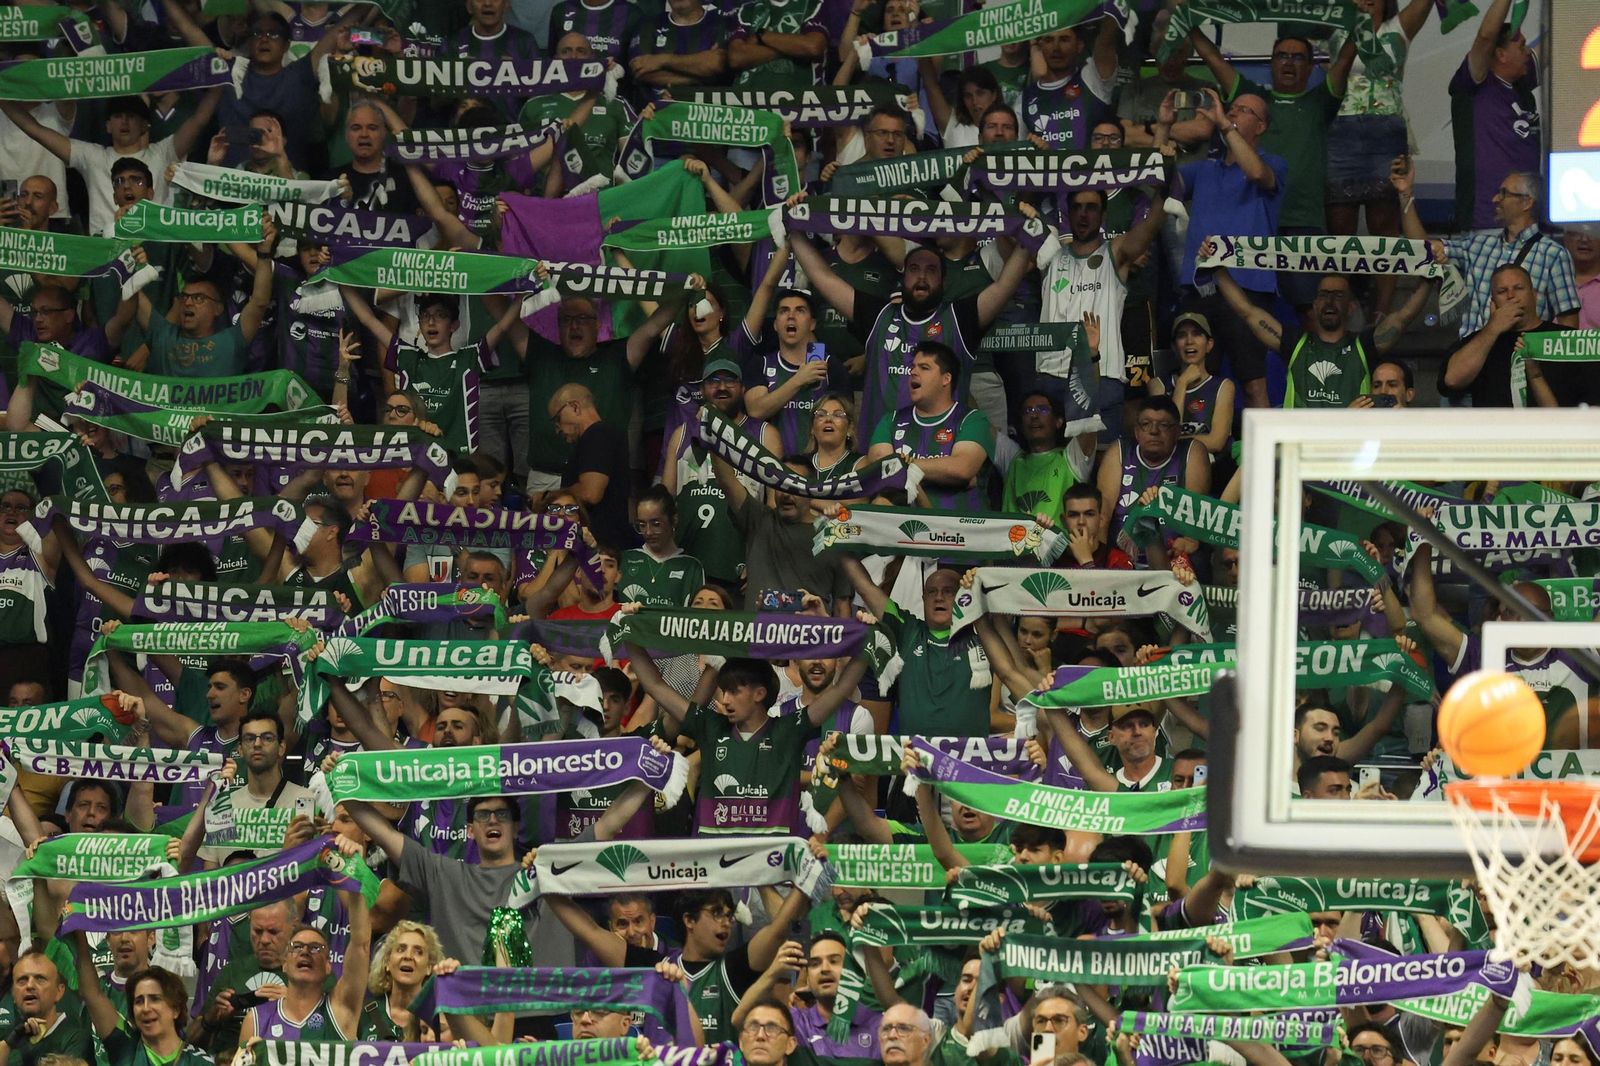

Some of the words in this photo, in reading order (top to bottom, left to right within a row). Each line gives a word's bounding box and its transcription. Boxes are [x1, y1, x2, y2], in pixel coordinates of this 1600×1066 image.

[979, 0, 1044, 27] UNICAJA
[965, 11, 1058, 46] BALONCESTO
[47, 57, 146, 78] BALONCESTO
[396, 59, 569, 87] UNICAJA
[687, 104, 755, 125] UNICAJA
[396, 117, 564, 160] UNICAJ
[671, 121, 769, 143] BALONCESTO
[874, 157, 941, 188] UNICAJA
[986, 151, 1165, 188] UNICAJA
[159, 206, 237, 232] Unicaja
[671, 211, 738, 228] UNICAJA
[829, 198, 1005, 235] UNICAJA
[658, 223, 752, 246] BALONCESTO
[1247, 236, 1415, 257] UNICAJA
[392, 252, 455, 271] UNICAJA
[377, 267, 468, 289] BALONCESTO
[778, 269, 793, 289] 4
[980, 335, 1016, 349] NUESTRA
[1017, 333, 1053, 348] HISTORIA
[87, 366, 170, 404] UNICAJA
[1307, 388, 1341, 402] Unicaja
[222, 427, 412, 463] UNICAJA
[69, 501, 254, 539] UNICAJA
[697, 504, 716, 529] 9
[929, 532, 965, 544] Unicaja
[106, 571, 141, 588] Unicaja
[145, 583, 327, 621] UNICAJA
[1068, 591, 1126, 609] Unicaja
[131, 631, 240, 651] BALONCESTO
[660, 616, 730, 642] UNICAJA
[733, 618, 844, 645] BALONCESTO
[375, 639, 533, 676] Unicaja
[1102, 669, 1212, 700] BALONCESTO
[1400, 665, 1431, 692] Unicaja
[26, 737, 210, 764] UNICAJA
[846, 734, 1030, 762] UNCAJ
[376, 757, 472, 787] Unicaja
[478, 748, 623, 778] Baloncesto
[736, 784, 768, 796] Unicaja
[1030, 789, 1109, 816] UNICAJA
[1004, 798, 1125, 832] BALONCESTO
[75, 838, 150, 855] UNICAJA
[838, 844, 916, 861] UNICAJA
[648, 862, 707, 881] Unicaja
[1039, 864, 1136, 893] Unicaja
[85, 886, 174, 923] UNICAJA
[181, 860, 300, 919] BALONCESTO
[975, 880, 1010, 900] Unicaja
[1277, 890, 1308, 910] Unicaja
[1336, 877, 1431, 902] Unicaja
[920, 906, 1026, 934] Unicaja
[1005, 943, 1084, 976] UNICAJA
[1090, 949, 1202, 978] BALONCESTO
[1208, 965, 1306, 997] Unicaja
[1313, 951, 1466, 988] Baloncesto
[1145, 1014, 1215, 1036] UNICAJA
[1221, 1016, 1322, 1039] BALONCESTO
